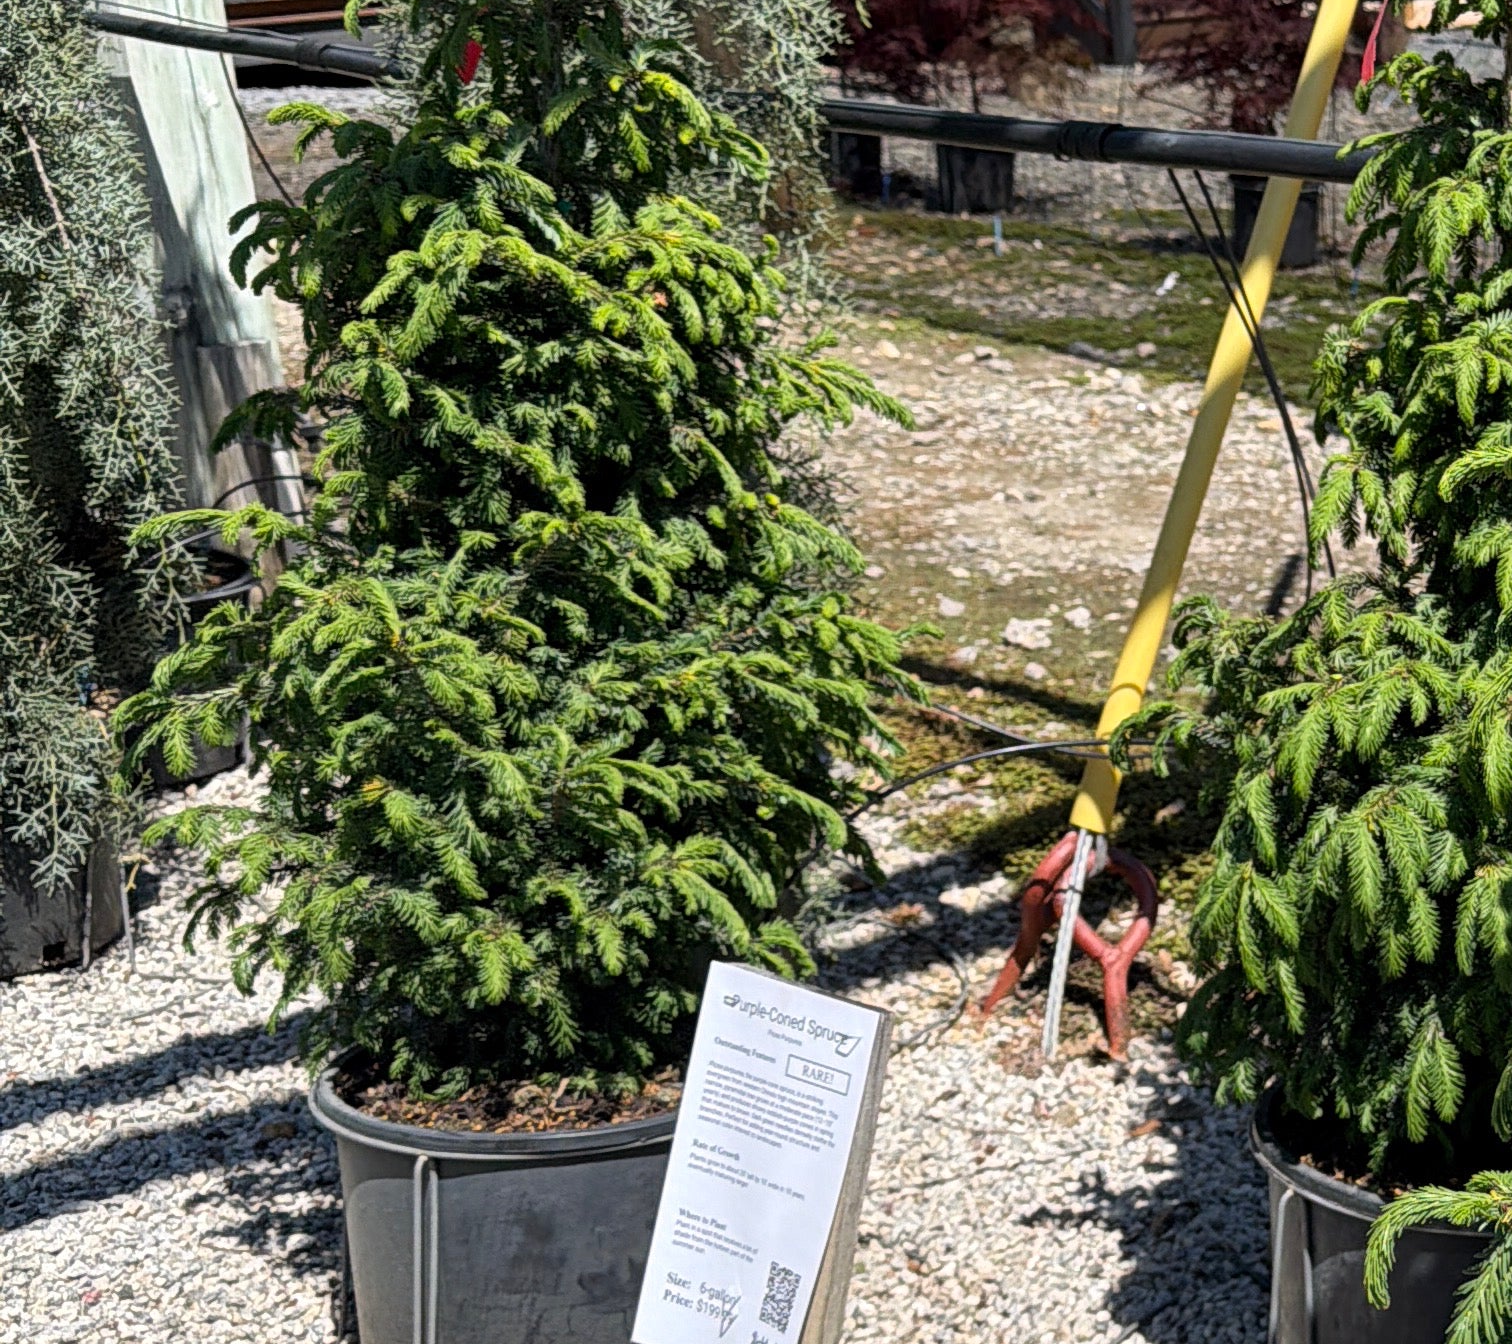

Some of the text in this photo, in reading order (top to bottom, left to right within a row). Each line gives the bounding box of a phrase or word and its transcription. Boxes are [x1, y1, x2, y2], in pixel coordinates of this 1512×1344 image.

[807, 1020, 850, 1047] Spruce
[802, 1065, 834, 1085] RARE!
[693, 1139, 708, 1150] Rate
[718, 1147, 740, 1161] Growth
[710, 1218, 727, 1231] Plant
[667, 1272, 691, 1289] Size:
[663, 1289, 694, 1308] Price:
